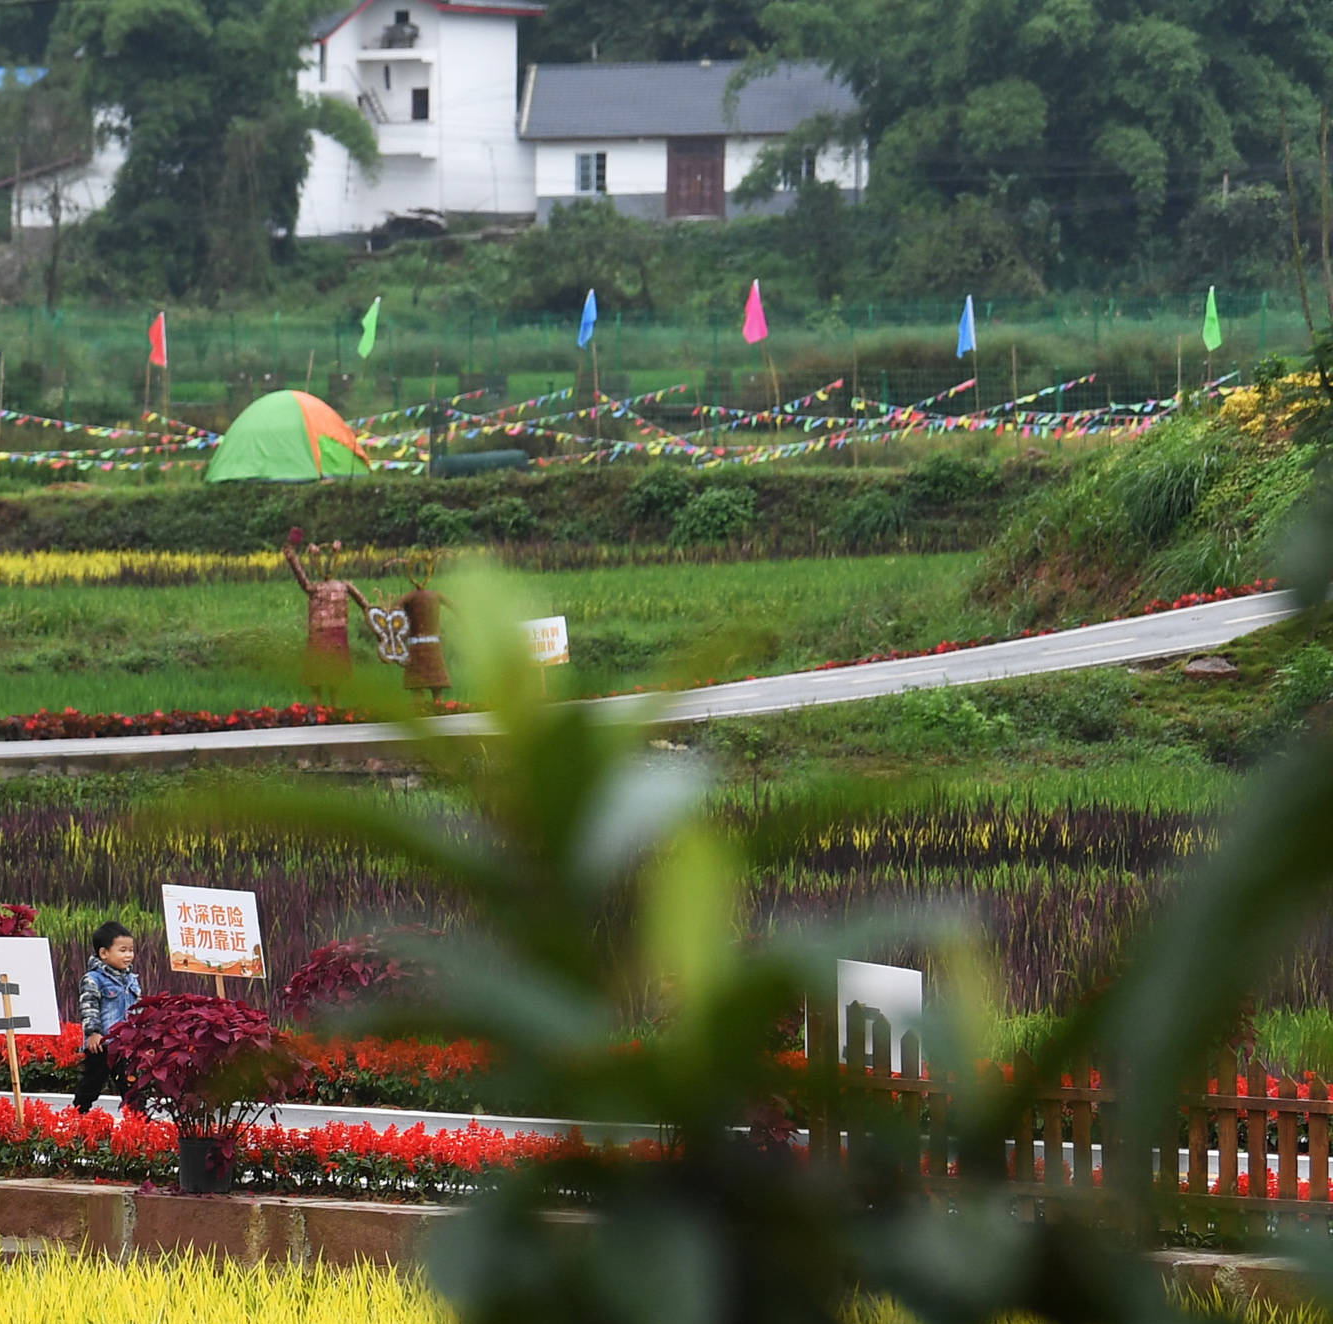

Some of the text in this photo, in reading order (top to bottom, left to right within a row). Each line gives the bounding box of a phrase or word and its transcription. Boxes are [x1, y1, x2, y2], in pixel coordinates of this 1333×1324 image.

[177, 901, 244, 927] 水深危险
[180, 926, 248, 952] 请勿靠近
